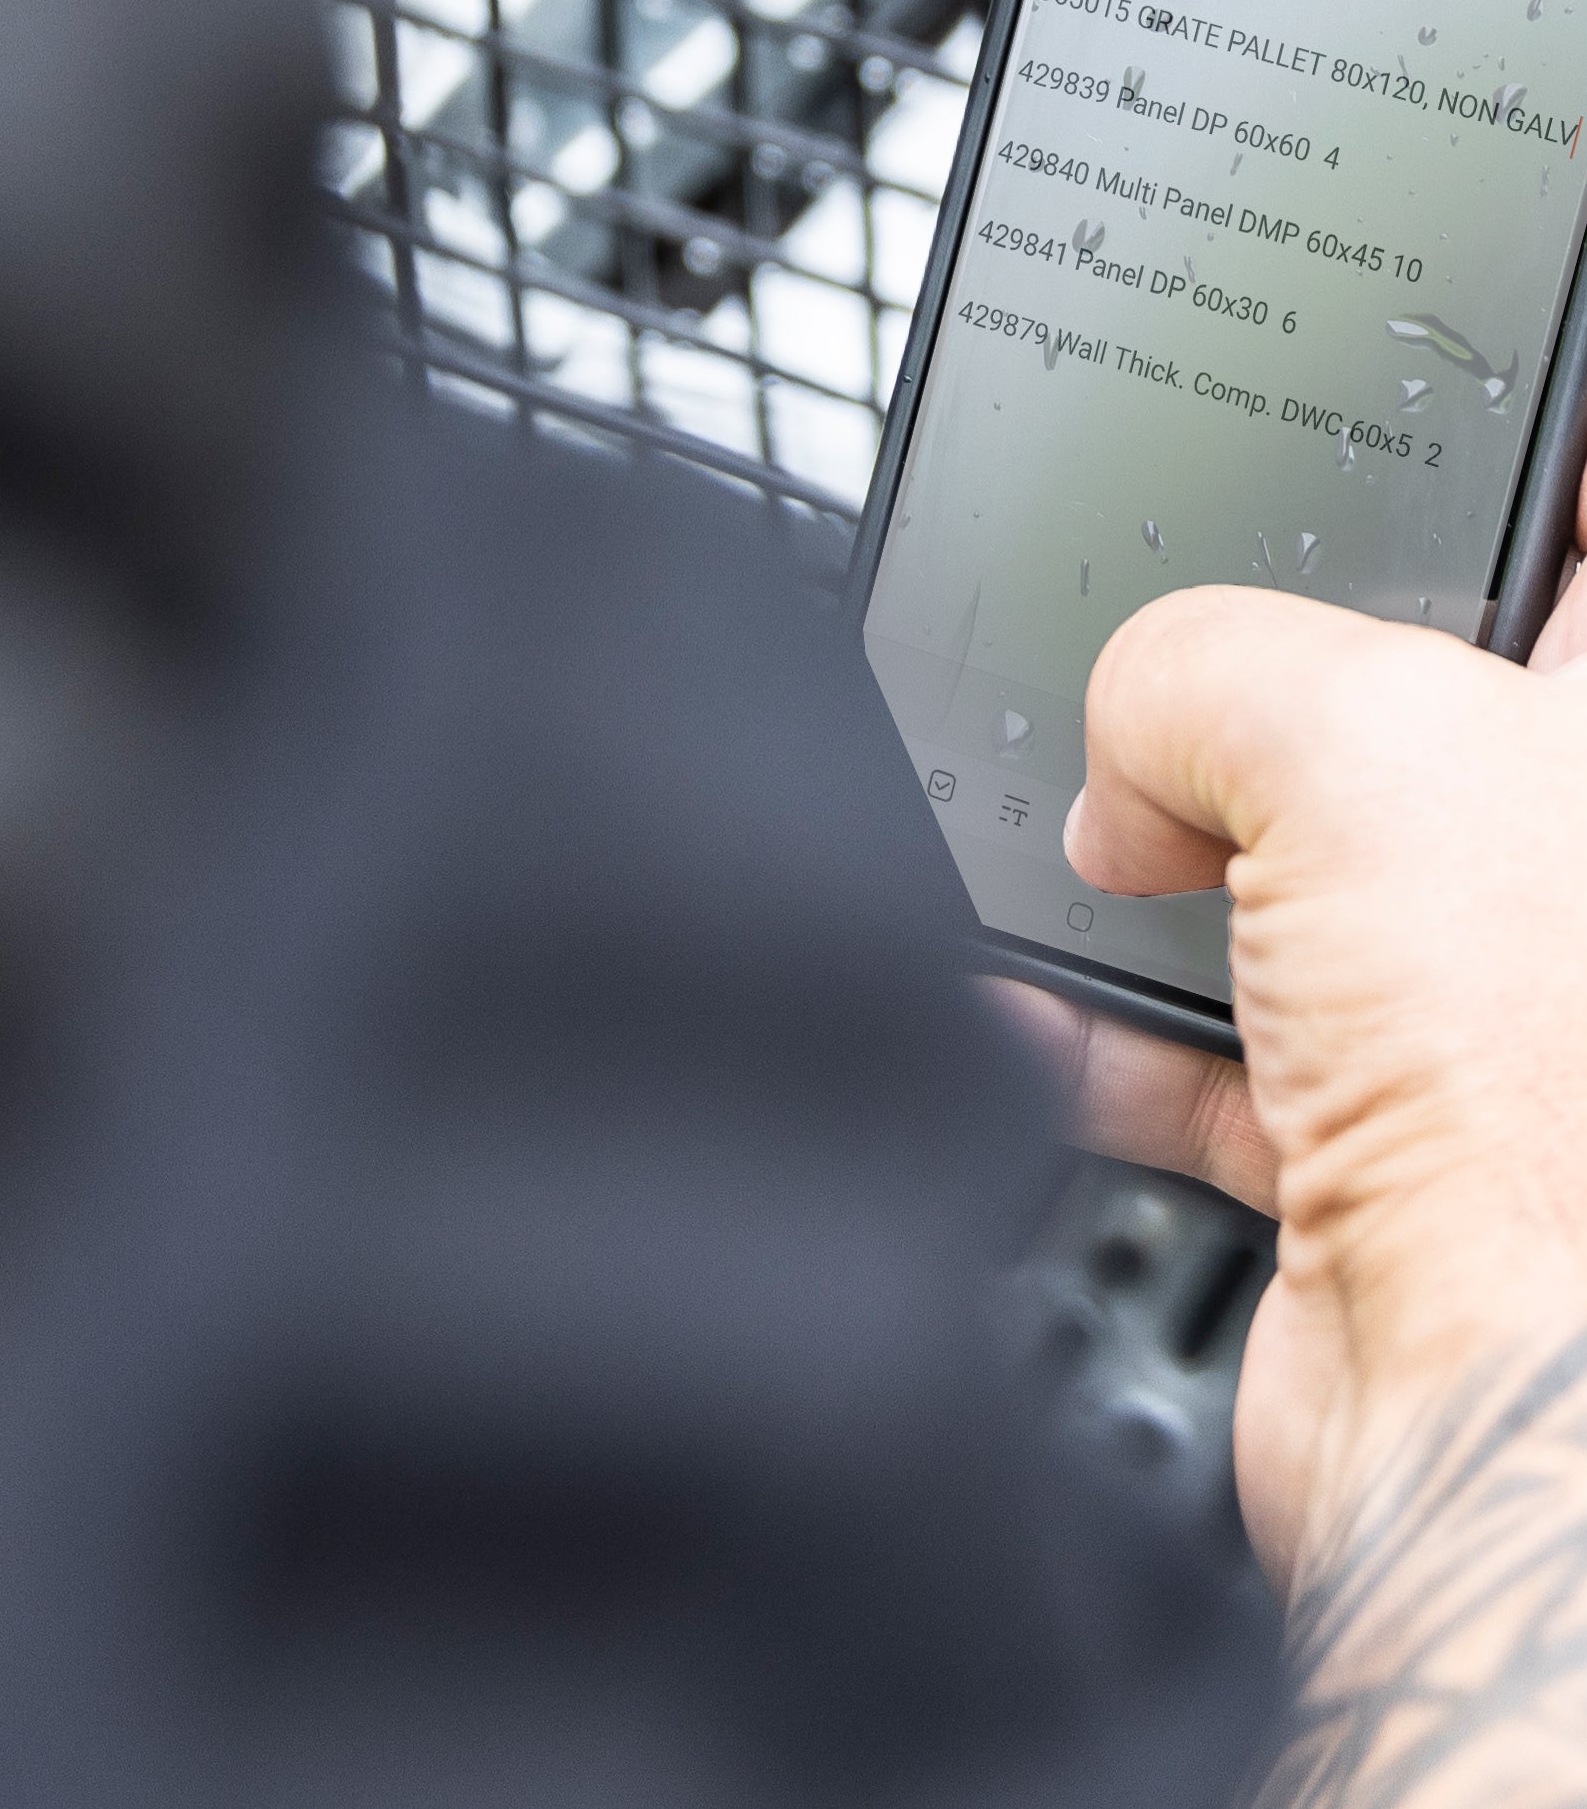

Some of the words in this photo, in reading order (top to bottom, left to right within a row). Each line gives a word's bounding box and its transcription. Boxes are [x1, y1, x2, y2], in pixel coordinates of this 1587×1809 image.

[1018, 60, 1111, 103] 429839
[1116, 86, 1186, 126] Panel
[1191, 108, 1228, 135] DP
[1234, 121, 1311, 161] 60x60
[1323, 147, 1341, 170] 4
[1138, 5, 1223, 48] GRATE
[1227, 29, 1327, 76] PALLET
[1331, 59, 1428, 110] 80x120,
[1437, 88, 1500, 126] NON
[1506, 107, 1579, 146] GALV
[978, 220, 1067, 265] 429841
[1075, 247, 1145, 288] Panel
[1149, 270, 1186, 298] DP
[1193, 284, 1268, 325] 60x30
[1282, 311, 1297, 334] 6
[998, 140, 1089, 185] 429840
[1095, 168, 1158, 206] Multi
[1163, 187, 1233, 228] Panel
[1238, 208, 1300, 245] DMP
[1306, 230, 1385, 272] 60x45
[1393, 255, 1423, 283] 10
[958, 301, 1049, 345] 429879
[1057, 328, 1108, 365] Wall
[1116, 346, 1183, 389] Thick.
[1193, 372, 1271, 417] Comp.
[1281, 398, 1343, 436] DWC
[1350, 421, 1412, 458] 60x5
[1425, 443, 1442, 468] 2
